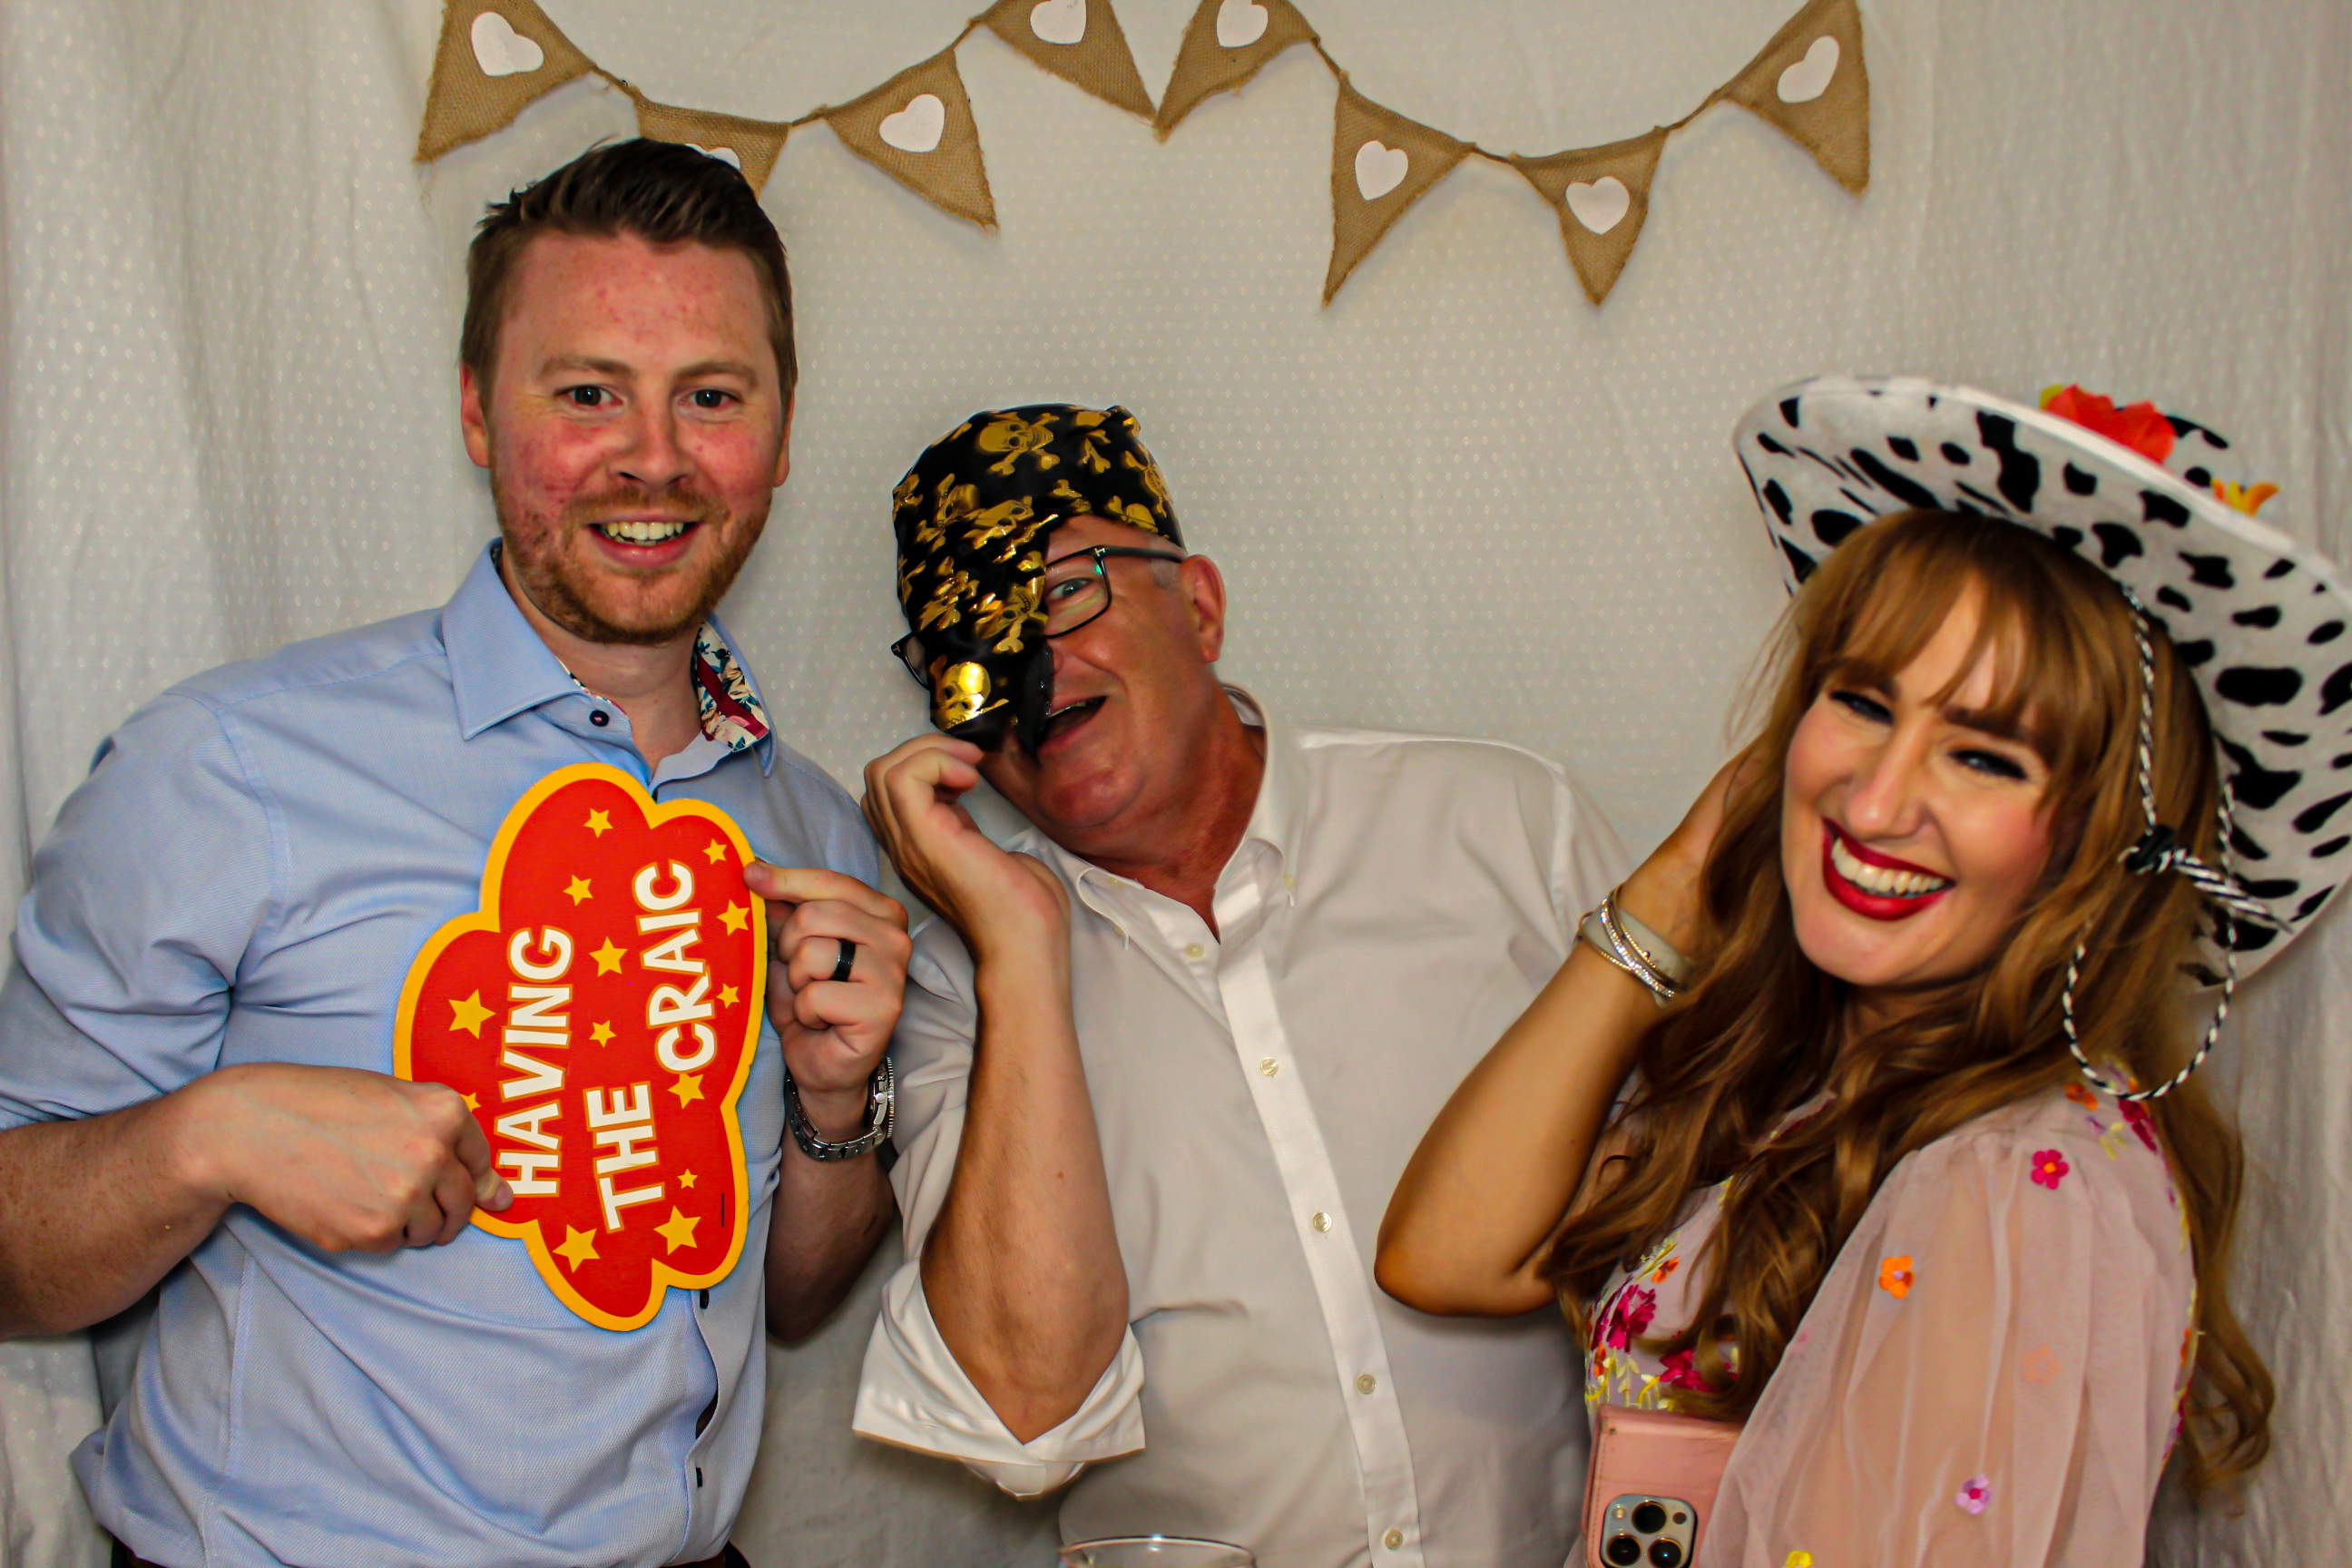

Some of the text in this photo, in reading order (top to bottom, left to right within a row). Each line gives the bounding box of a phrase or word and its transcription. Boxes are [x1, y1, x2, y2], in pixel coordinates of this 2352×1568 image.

[496, 927, 573, 1196] HAVING
[634, 862, 716, 1072] CRAIC
[587, 1083, 663, 1230] THE
